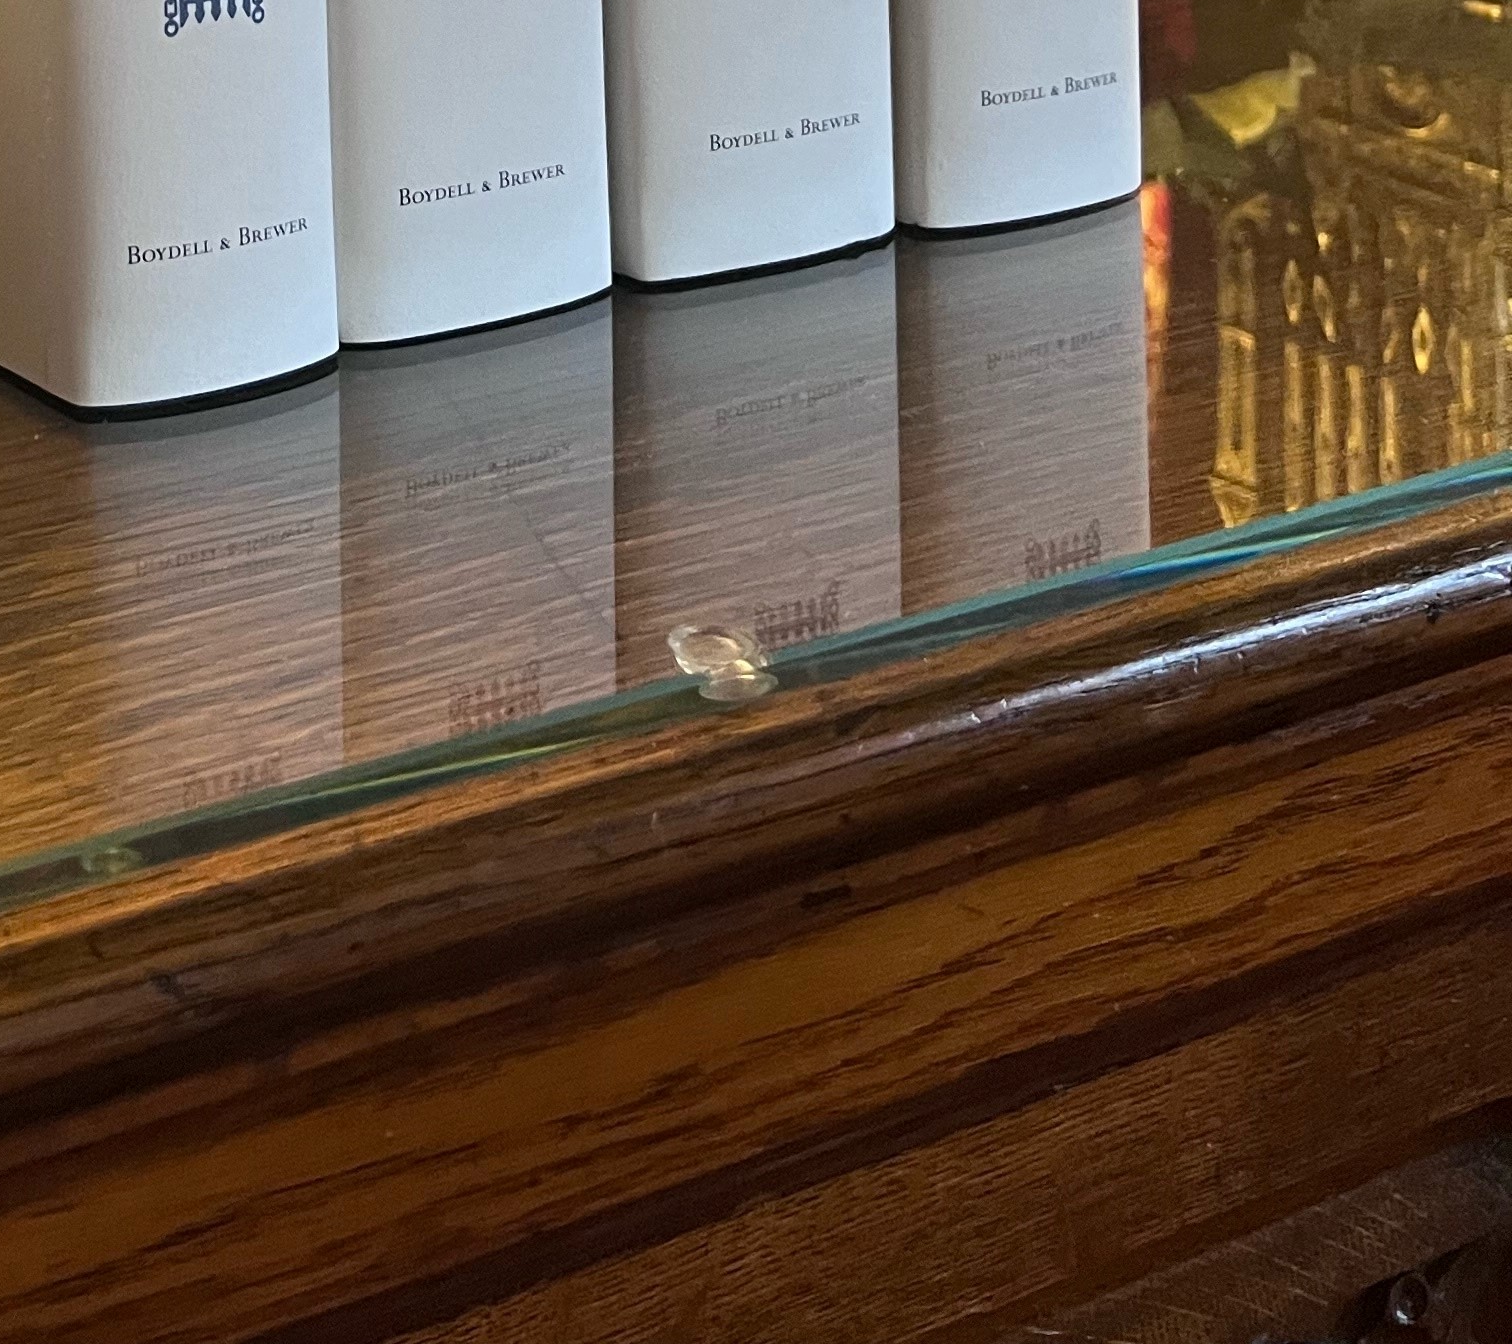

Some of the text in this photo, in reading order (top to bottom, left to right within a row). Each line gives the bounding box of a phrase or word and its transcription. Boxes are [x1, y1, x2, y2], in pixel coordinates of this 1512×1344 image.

[1050, 85, 1060, 97] &
[784, 127, 795, 140] &
[481, 180, 492, 193] &
[219, 237, 231, 251] &
